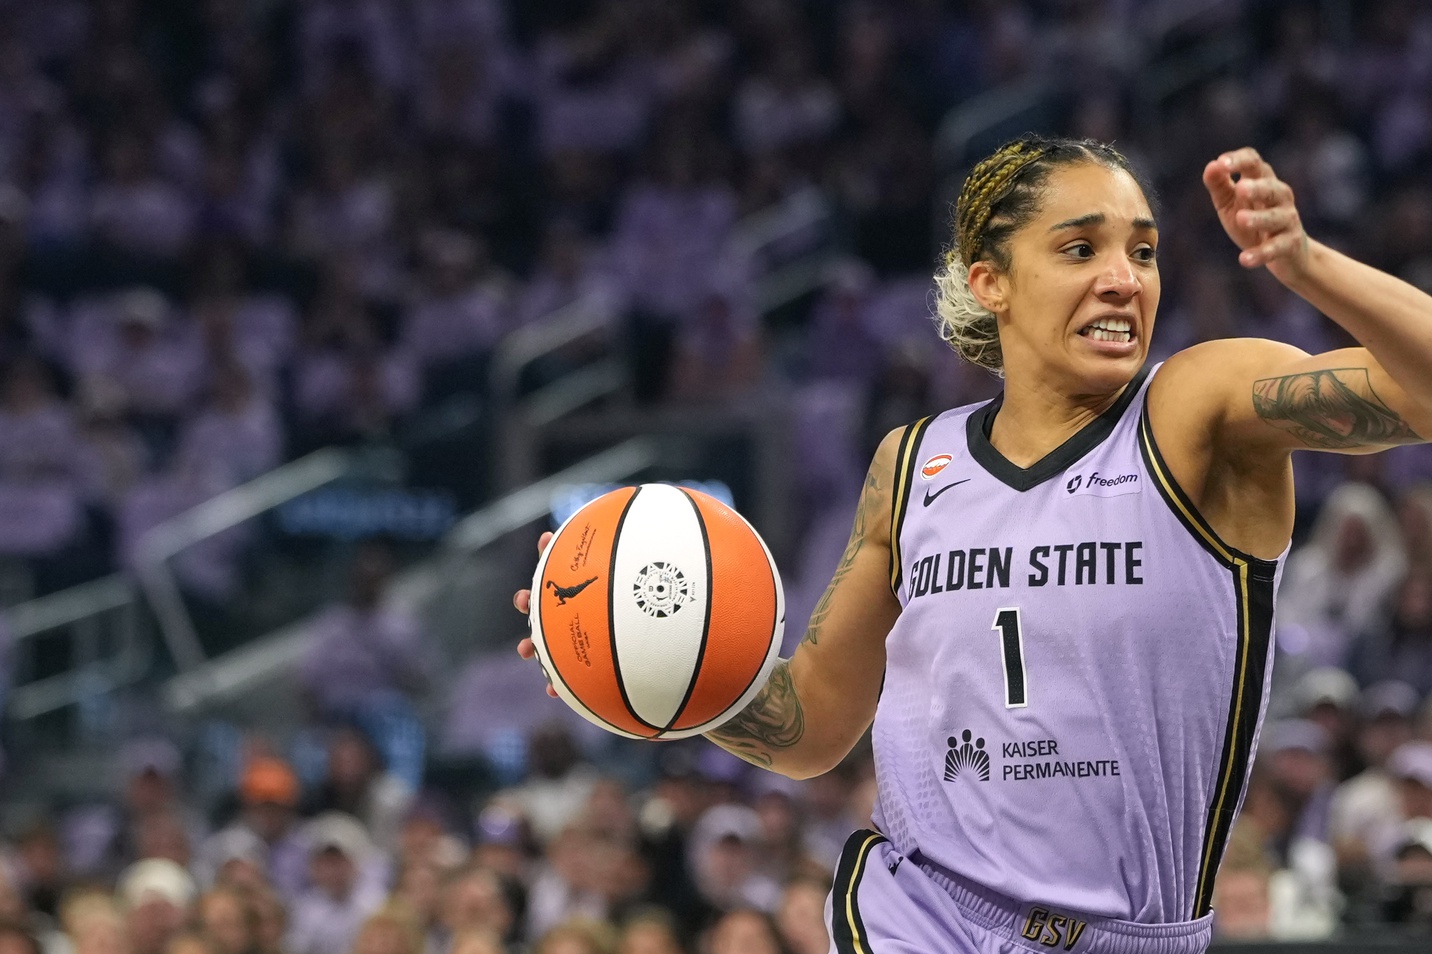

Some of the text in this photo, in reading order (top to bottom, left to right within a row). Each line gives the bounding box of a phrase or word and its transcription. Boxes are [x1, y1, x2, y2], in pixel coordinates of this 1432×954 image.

[1085, 471, 1138, 489] freedom
[908, 541, 1144, 599] GOLDEN STATE
[569, 621, 582, 663] OFFICIAL
[574, 612, 584, 639] BALL
[991, 606, 1028, 709] 1
[1002, 739, 1059, 758] KAISER
[1002, 760, 1121, 782] PERMANENTE
[1021, 906, 1087, 950] GSV
